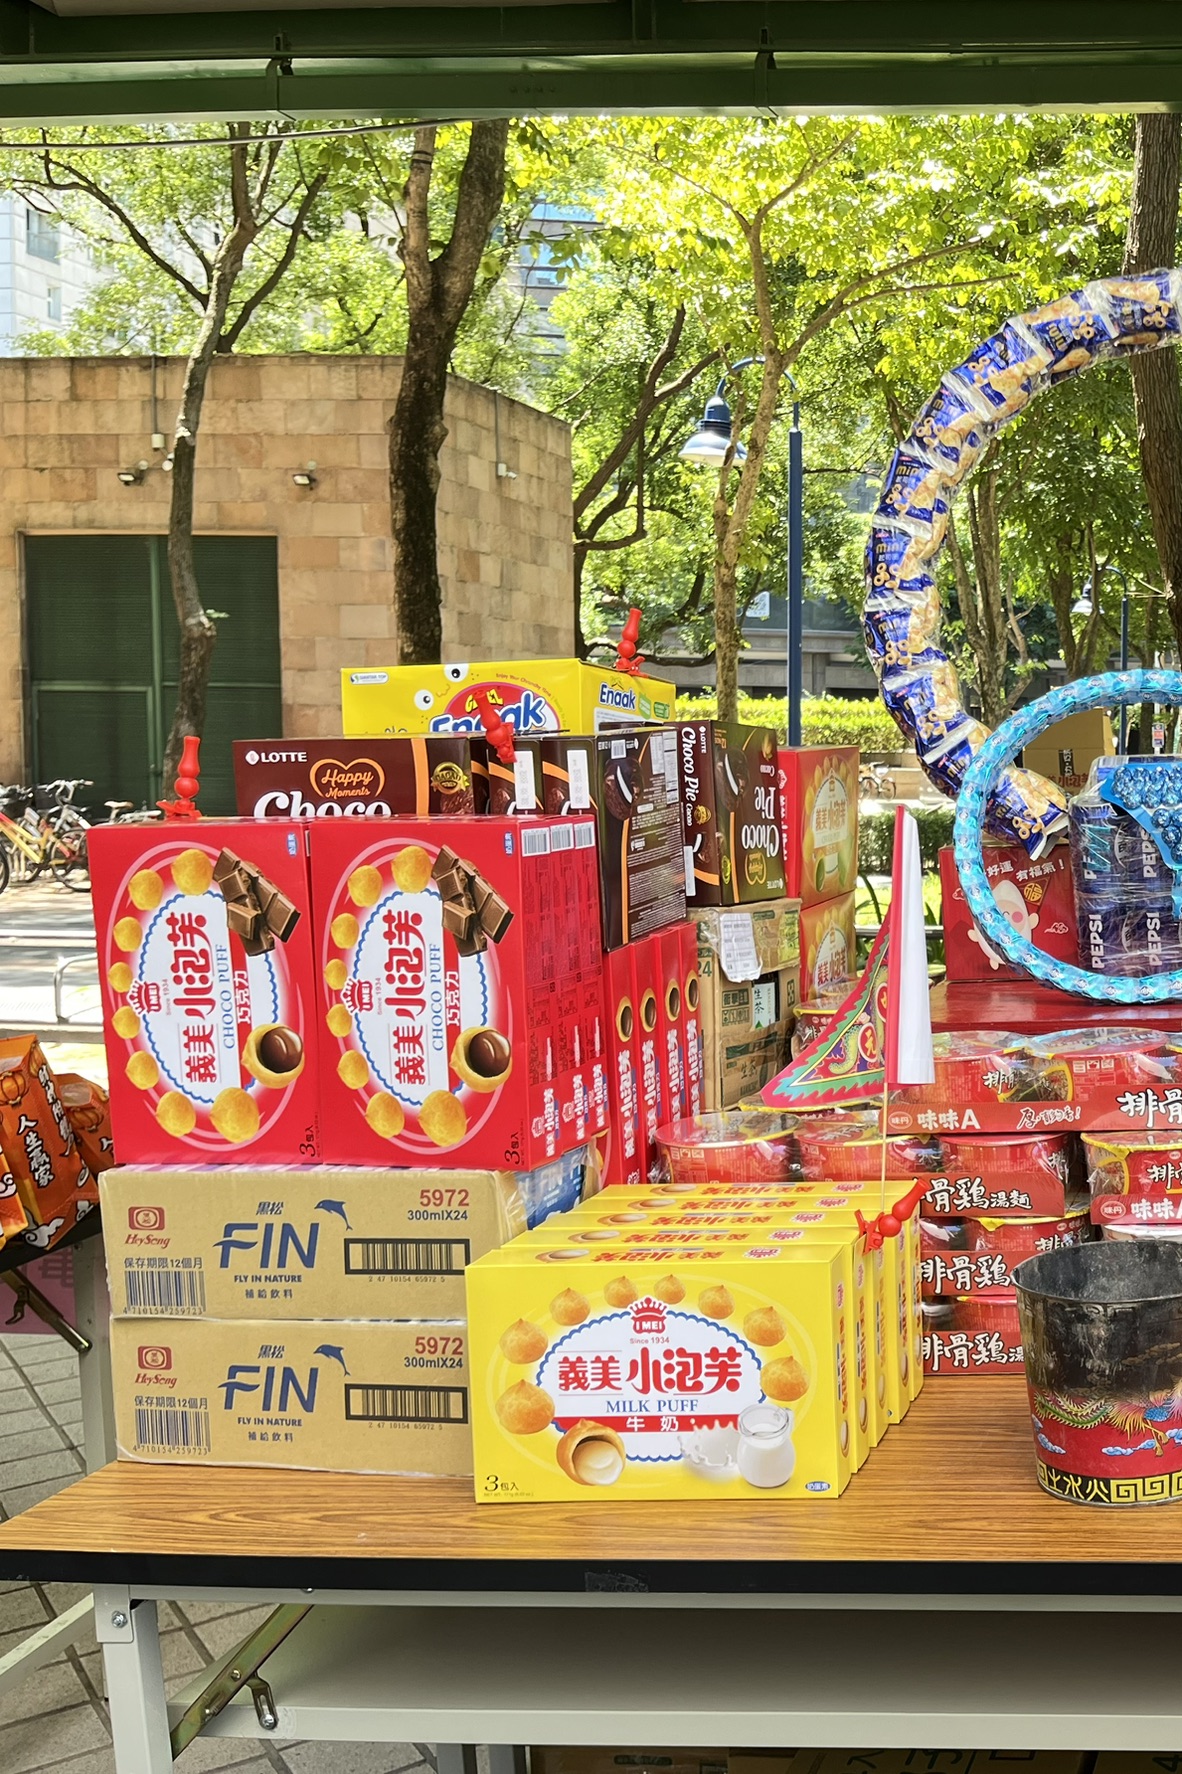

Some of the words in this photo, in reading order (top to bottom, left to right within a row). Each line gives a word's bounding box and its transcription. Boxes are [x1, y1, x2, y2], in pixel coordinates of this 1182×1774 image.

[600, 682, 636, 710] Enaak
[261, 751, 308, 763] LOTTE
[681, 727, 698, 775] Choco
[320, 768, 375, 787] Happy
[684, 774, 700, 802] Pie
[325, 787, 371, 799] Moments
[754, 786, 776, 820] Pie
[741, 824, 780, 857] Choco
[1089, 914, 1105, 969] PEPSI
[1146, 912, 1163, 967] PEPSI
[215, 944, 231, 983] PUFF
[428, 943, 441, 983] PUFF
[166, 911, 217, 1083] 義美小泡芙
[233, 970, 251, 1024] 巧克力
[382, 909, 428, 1086] 義美小泡芙
[445, 970, 460, 1027] 巧克力
[220, 992, 236, 1050] CHOCO
[431, 994, 444, 1051] CHOCO
[917, 1108, 981, 1131] 味味A
[17, 1115, 55, 1188] 人生贏家
[255, 1201, 285, 1216] 黑松
[419, 1189, 470, 1207] 5972
[407, 1209, 469, 1222] 300mlX24
[212, 1222, 320, 1269] FIN
[124, 1257, 203, 1269] 保存期限12個月
[233, 1275, 250, 1283] FLY
[251, 1275, 262, 1283] IN
[264, 1275, 302, 1283] NATURE
[245, 1289, 293, 1299] 補給飲料
[256, 1345, 286, 1359] 黑松
[414, 1337, 464, 1356] 5972
[651, 1336, 670, 1344] 1934
[404, 1356, 463, 1369] 300mlX24
[557, 1346, 743, 1396] 義美小泡芙
[217, 1365, 319, 1413] FIN
[134, 1396, 208, 1410] 保存期限12個月
[606, 1400, 651, 1413] MILK
[656, 1399, 699, 1412] PUFF
[237, 1417, 252, 1425] FLY
[253, 1417, 264, 1425] IN
[266, 1418, 303, 1427] NATURE
[626, 1416, 680, 1433] 牛奶
[247, 1431, 294, 1442] 補給飲料
